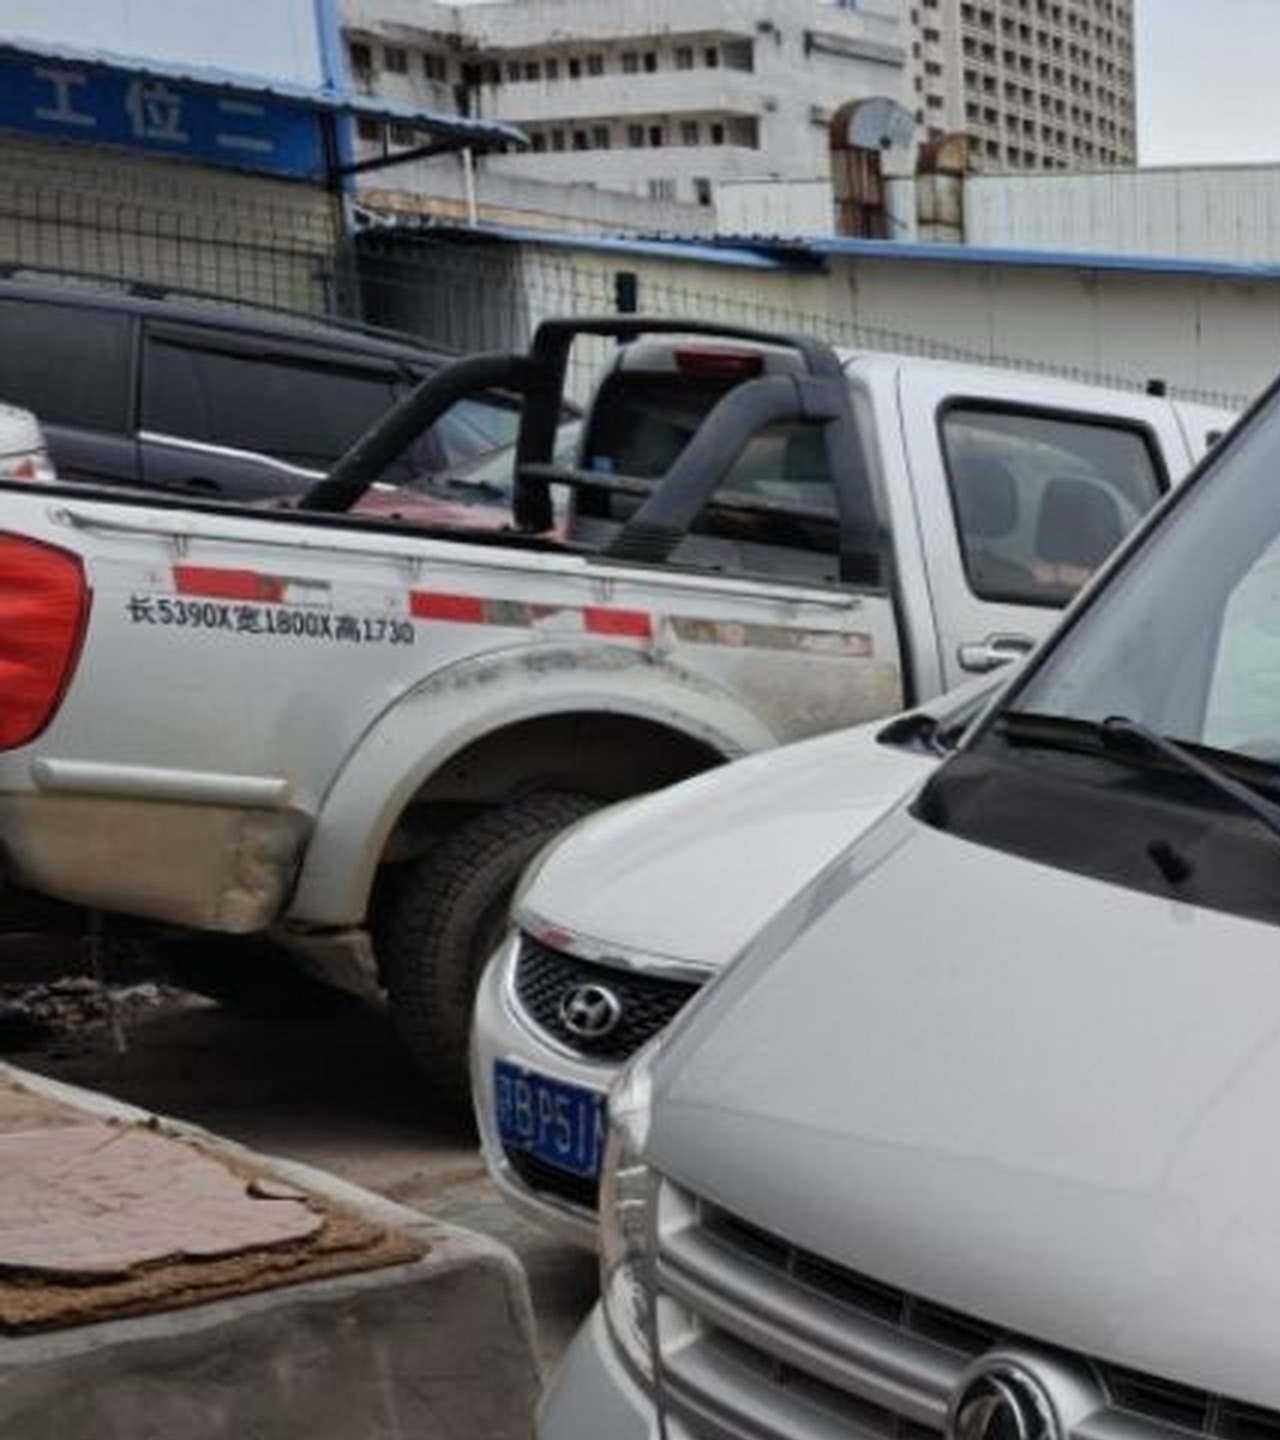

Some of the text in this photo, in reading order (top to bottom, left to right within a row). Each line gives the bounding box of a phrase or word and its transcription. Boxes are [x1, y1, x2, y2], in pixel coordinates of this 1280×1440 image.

[33, 69, 275, 152] 工位二
[127, 595, 415, 645] 长5390X宽1800X高1730
